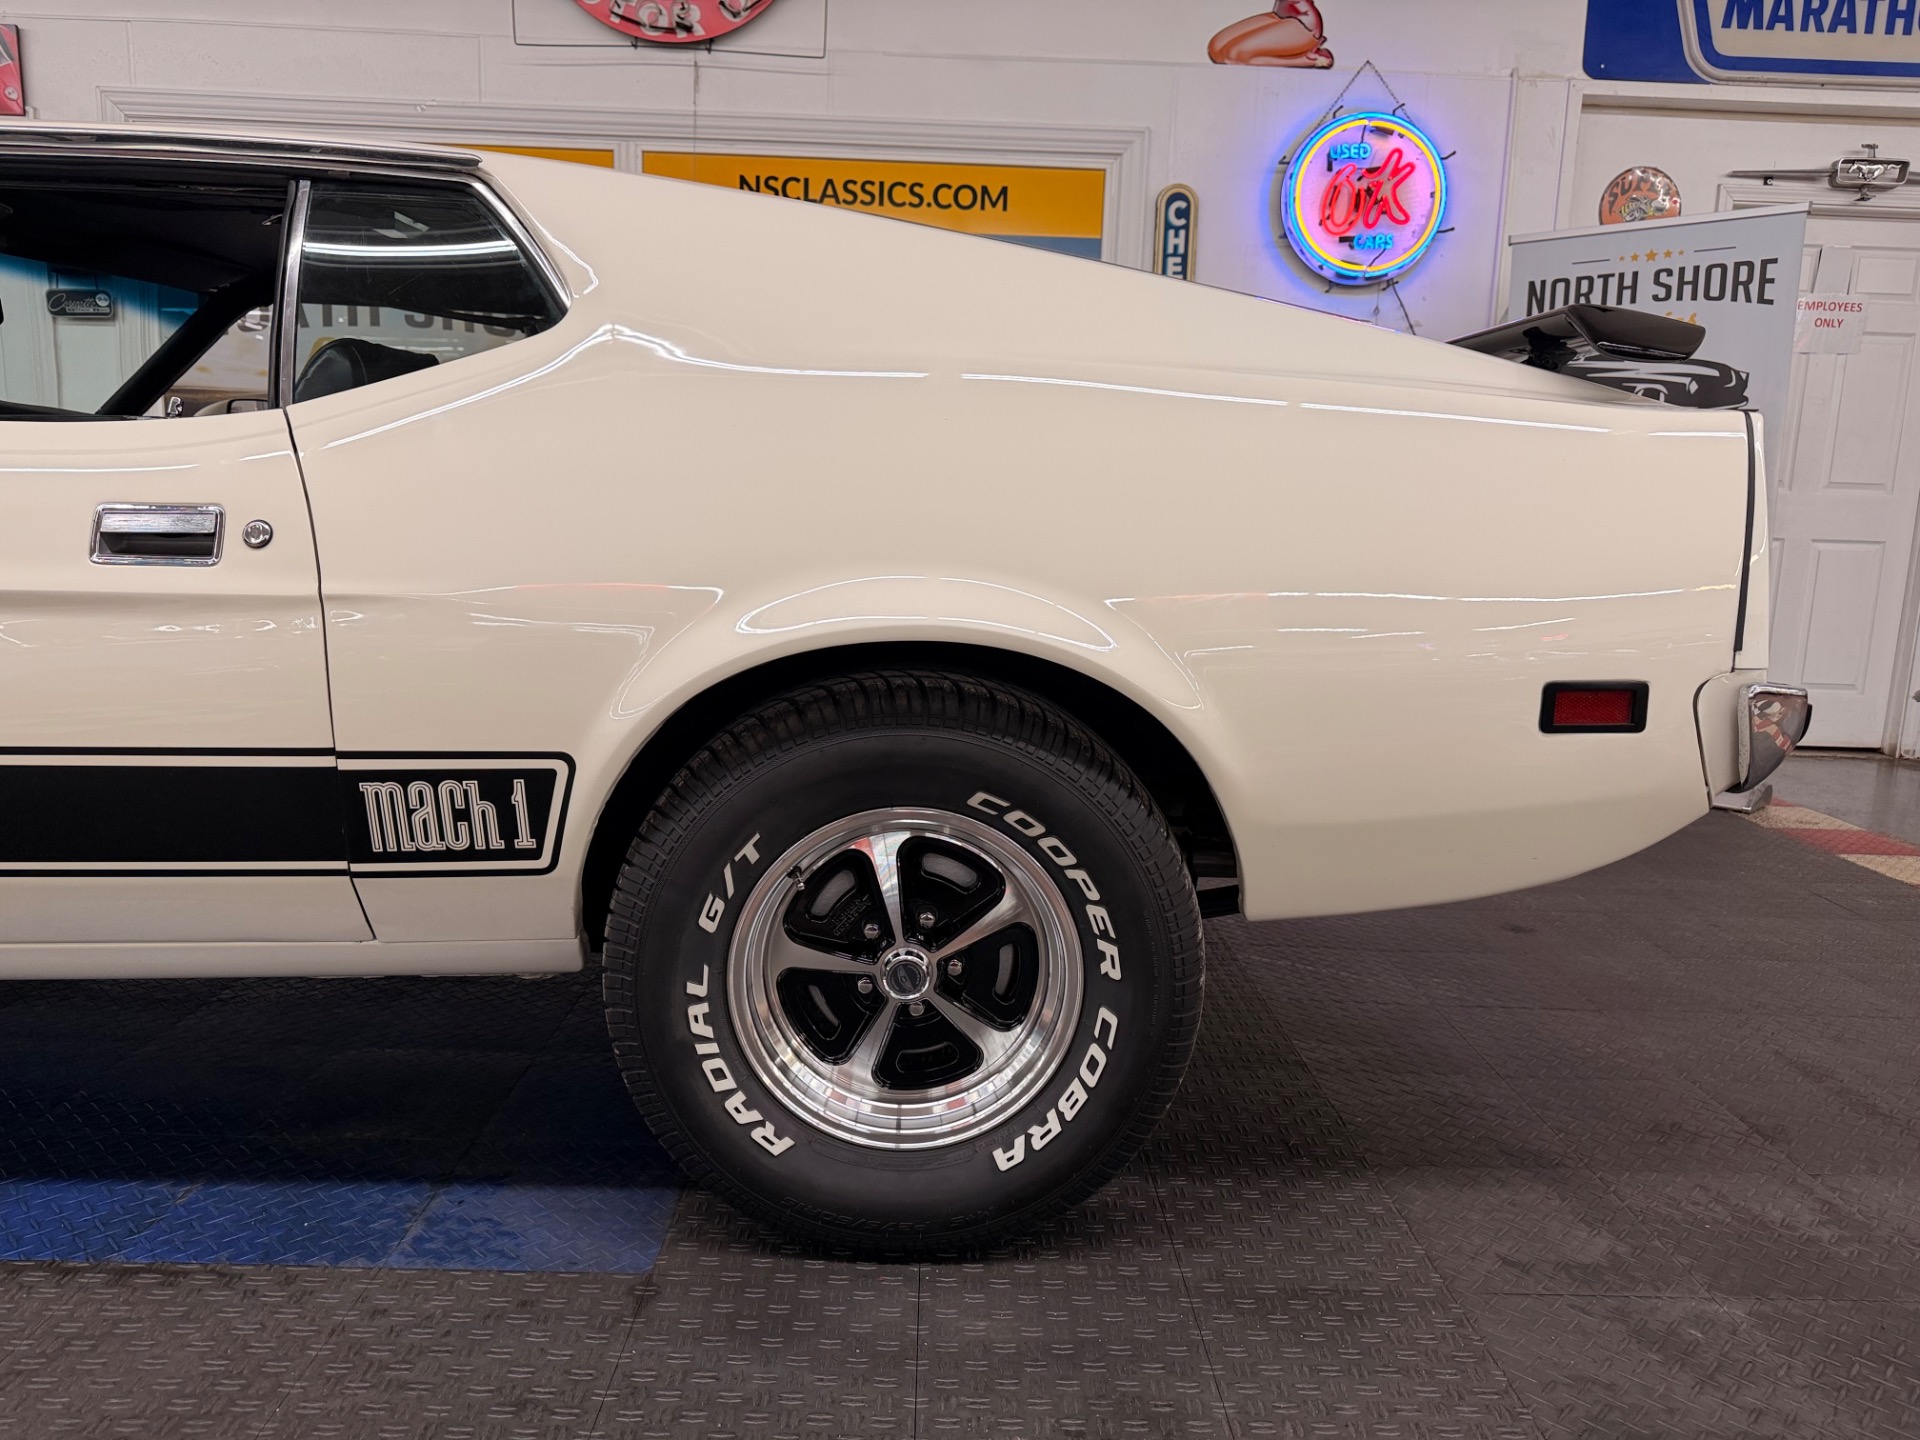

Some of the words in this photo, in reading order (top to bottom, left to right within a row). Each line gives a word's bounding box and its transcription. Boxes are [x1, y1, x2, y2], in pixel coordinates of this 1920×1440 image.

[1721, 0, 1920, 36] MARATH
[1329, 143, 1372, 159] USED
[739, 174, 1009, 212] NSCLASSICS.COM
[1321, 148, 1416, 236] OK
[1353, 233, 1394, 250] CARS
[1526, 270, 1639, 317] NORTH
[1651, 257, 1779, 306] SHORE
[1797, 300, 1863, 313] EMPLOYEES
[1814, 317, 1844, 329] ONLY
[359, 779, 505, 852] mach
[511, 778, 537, 849] 1
[698, 832, 761, 934] G/T
[966, 791, 1123, 981] COOPER
[686, 963, 796, 1157] RADIAL
[992, 1006, 1119, 1172] COBRA
